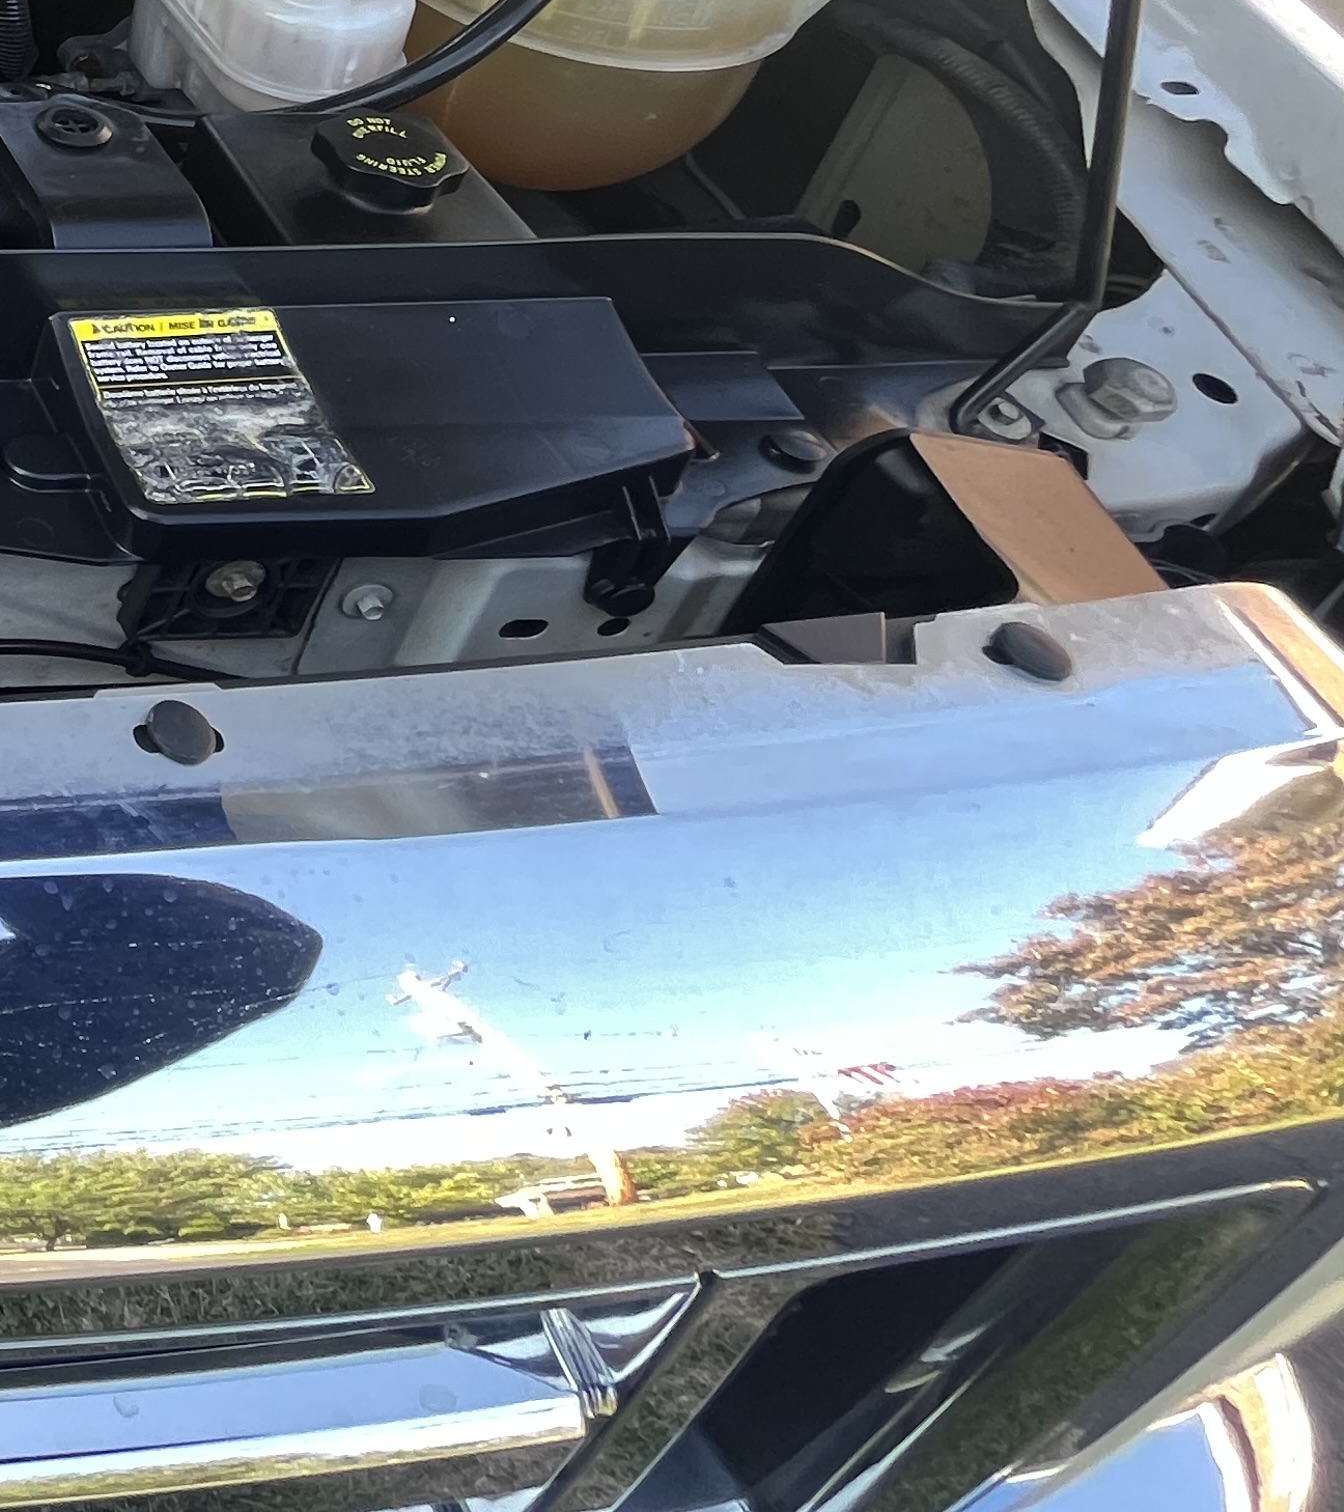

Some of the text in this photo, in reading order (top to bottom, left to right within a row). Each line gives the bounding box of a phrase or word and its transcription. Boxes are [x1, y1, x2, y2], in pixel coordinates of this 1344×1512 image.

[356, 153, 423, 176] STEERING
[386, 156, 427, 167] FLUID
[103, 323, 155, 334] CAUTION
[168, 320, 196, 330] MISE
[176, 346, 188, 354] of
[188, 345, 213, 353] cable
[144, 355, 164, 365] NOT
[160, 363, 187, 371] Owner
